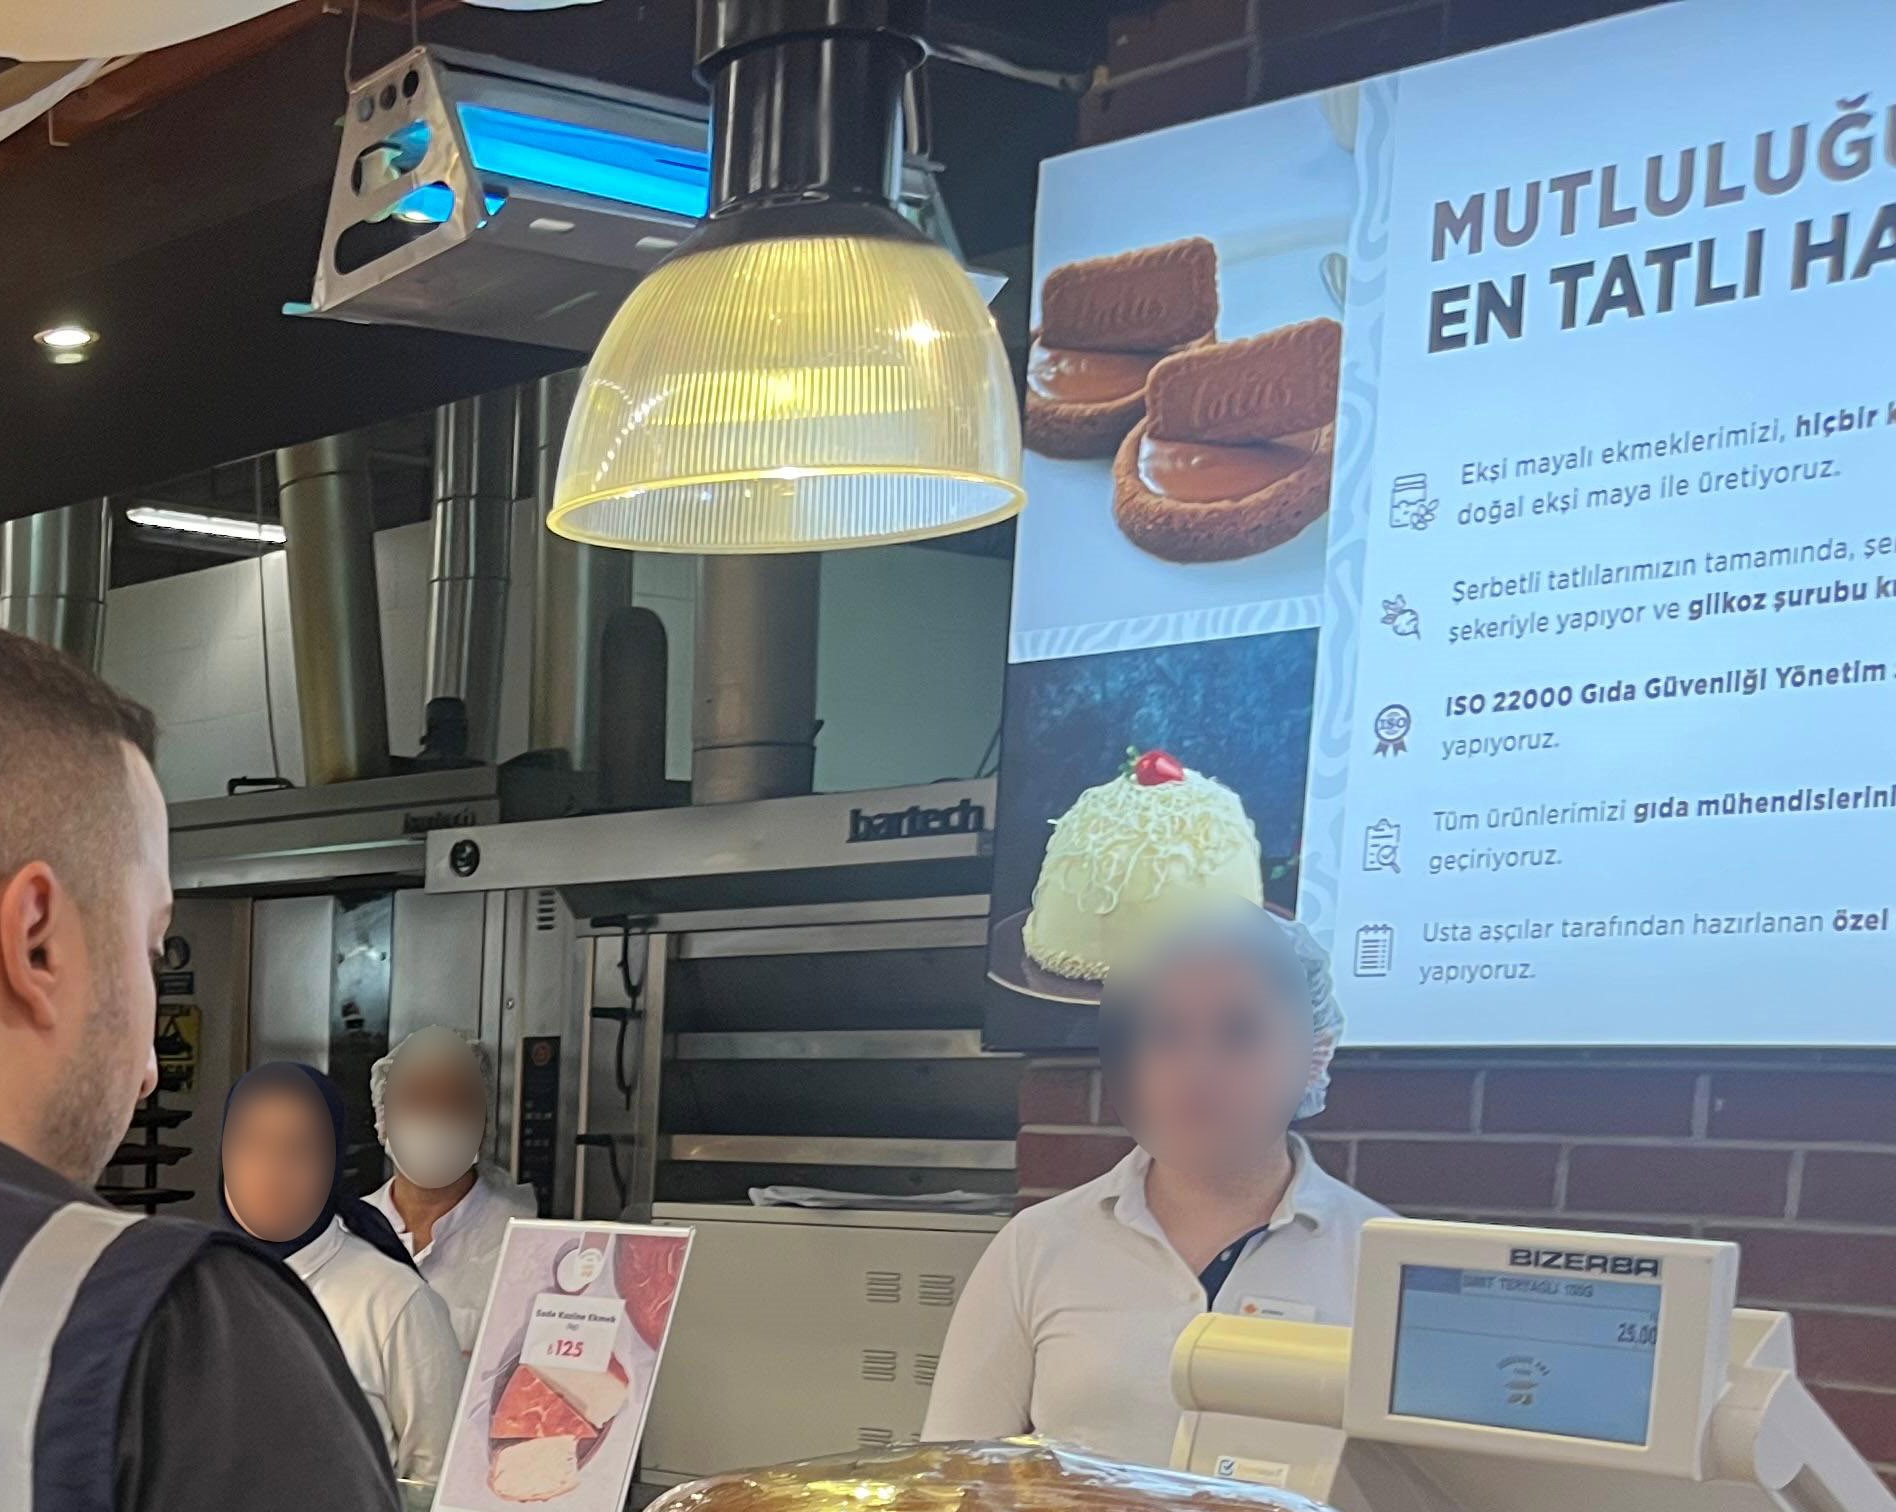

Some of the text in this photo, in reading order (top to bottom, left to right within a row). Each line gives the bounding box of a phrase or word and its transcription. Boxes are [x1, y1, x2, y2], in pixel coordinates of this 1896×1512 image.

[1428, 274, 1526, 353] EN
[1550, 229, 1765, 329] TATLI
[1462, 458, 1507, 485] Ekşi
[1516, 446, 1592, 477] mayalı
[1458, 496, 1524, 525] doğal
[1532, 488, 1579, 515] ekşi
[1587, 484, 1651, 507] maya
[1660, 475, 1689, 498] ile
[1864, 537, 1896, 559] şe
[1448, 612, 1549, 645] şekeriyle
[1556, 606, 1646, 635] yapıyor
[1653, 602, 1680, 620] ve
[1773, 580, 1868, 612] şurubu
[1446, 694, 1486, 717] ISO
[1492, 686, 1573, 712] 22000
[1580, 680, 1636, 704] Gıda
[1776, 660, 1886, 688] Yönetim
[1442, 732, 1559, 760] yapıyoruz.
[1433, 811, 1479, 831] Tüm
[1487, 799, 1626, 828] ürünlerimizi
[1634, 796, 1688, 823] gıda
[1429, 848, 1562, 874] geçiriyoruz.
[1424, 923, 1471, 942] Usta
[1562, 915, 1683, 938] tarafından
[1694, 912, 1823, 934] hazırlanan
[1833, 908, 1888, 931] özel
[1420, 963, 1535, 984] yapıyoruz.
[1509, 1248, 1659, 1278] BIZERBA
